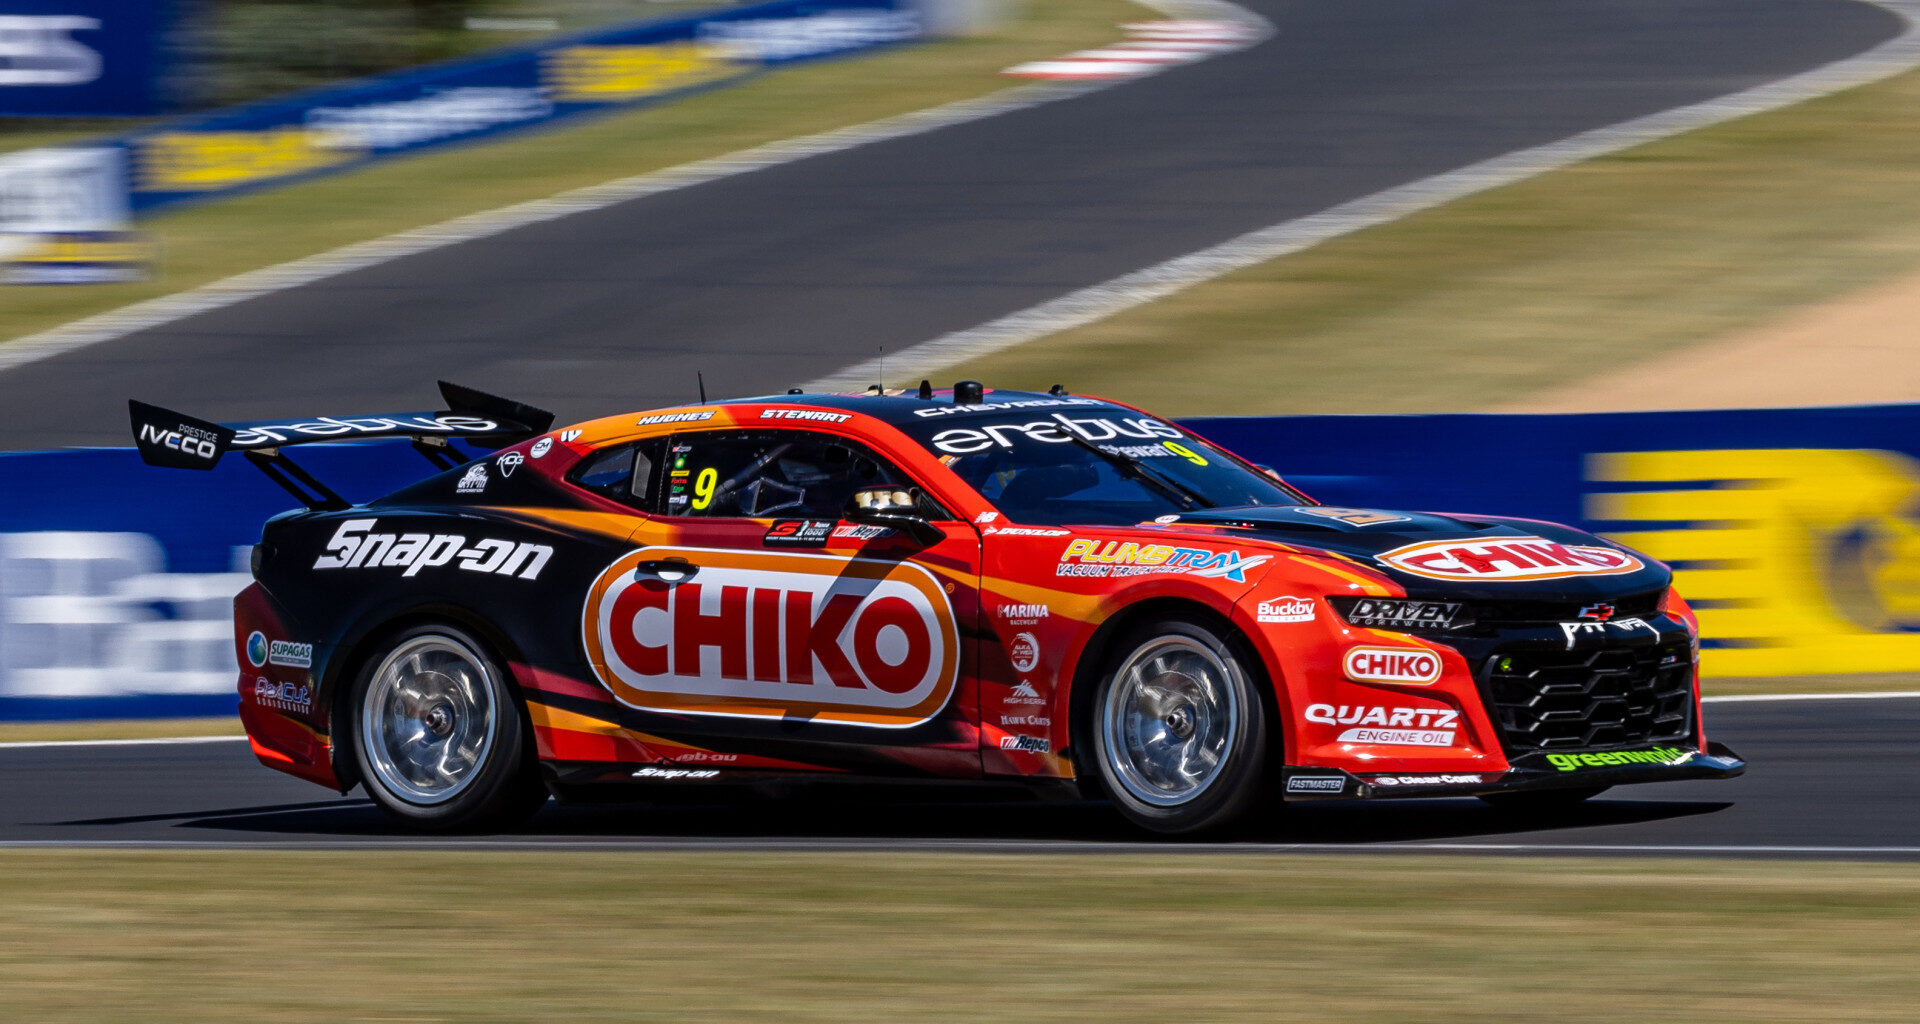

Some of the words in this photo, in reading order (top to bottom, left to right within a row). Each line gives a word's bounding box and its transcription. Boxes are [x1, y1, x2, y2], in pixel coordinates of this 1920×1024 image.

[637, 410, 717, 425] HUGHES
[760, 409, 852, 423] STEWART
[140, 423, 216, 459] IVECO
[178, 424, 218, 443] PRESTIGE
[932, 413, 1184, 453] erebus
[1162, 440, 1209, 467] 9
[692, 467, 718, 509] 9
[996, 527, 1071, 537] DUNLOP
[312, 518, 554, 580] Snap-on
[1402, 543, 1626, 574] CHIKO
[1056, 563, 1110, 577] VACUUM
[1110, 565, 1151, 577] TRUCK
[997, 604, 1049, 618] MARINA
[1257, 601, 1315, 617] Buckby
[1350, 599, 1460, 622] DRIVEN
[1349, 617, 1450, 629] WORKWEAR
[609, 578, 932, 695] CHIKO
[271, 643, 311, 658] SUPAGAS
[1351, 653, 1434, 678] CHIKO
[1304, 703, 1459, 729] QUARTZ
[1013, 735, 1049, 752] Repco
[1356, 730, 1418, 743] ENGINE
[1421, 732, 1448, 744] OIL
[631, 767, 720, 779] Snap-on
[1290, 779, 1341, 790] FASTMASTER
